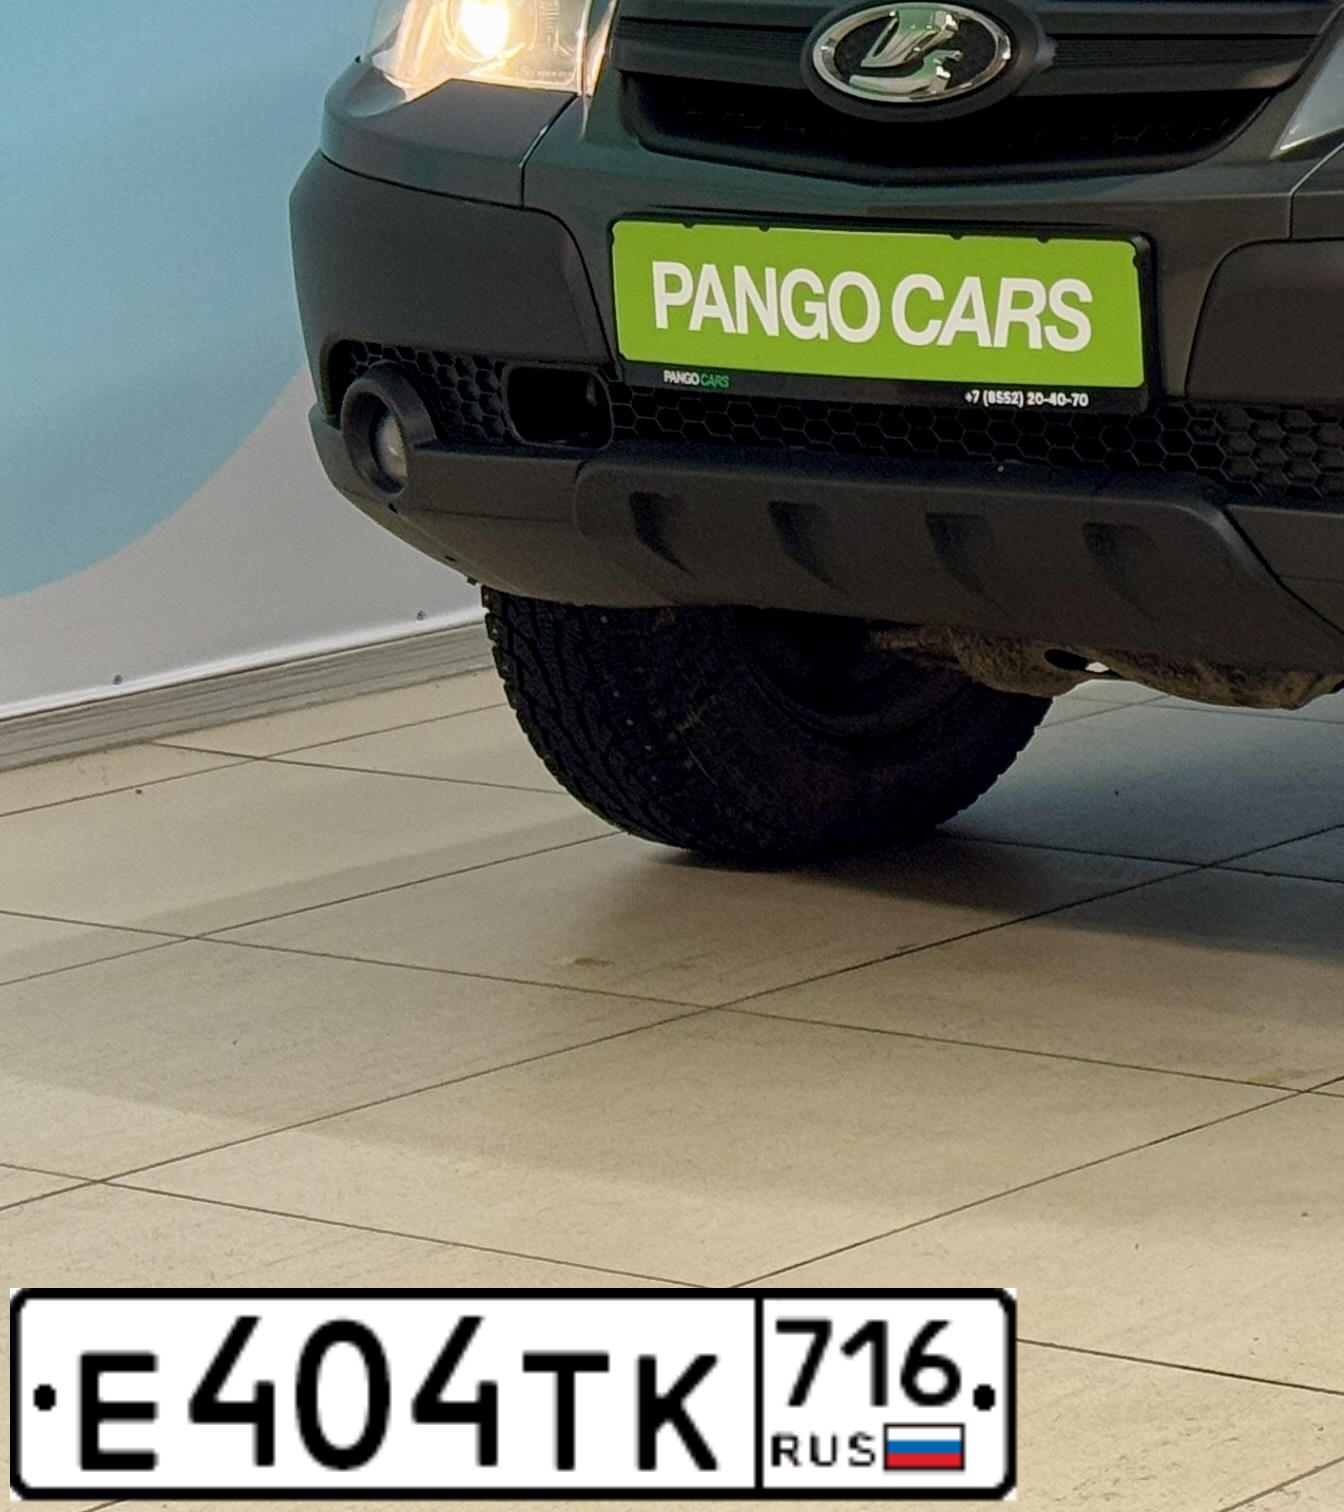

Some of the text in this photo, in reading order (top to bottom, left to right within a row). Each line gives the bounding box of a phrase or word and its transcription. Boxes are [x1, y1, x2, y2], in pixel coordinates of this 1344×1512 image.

[652, 261, 1093, 352] PANGO CARS
[663, 369, 730, 388] PANGO CARS
[964, 389, 1089, 408] +7 (8552) 20-40-70
